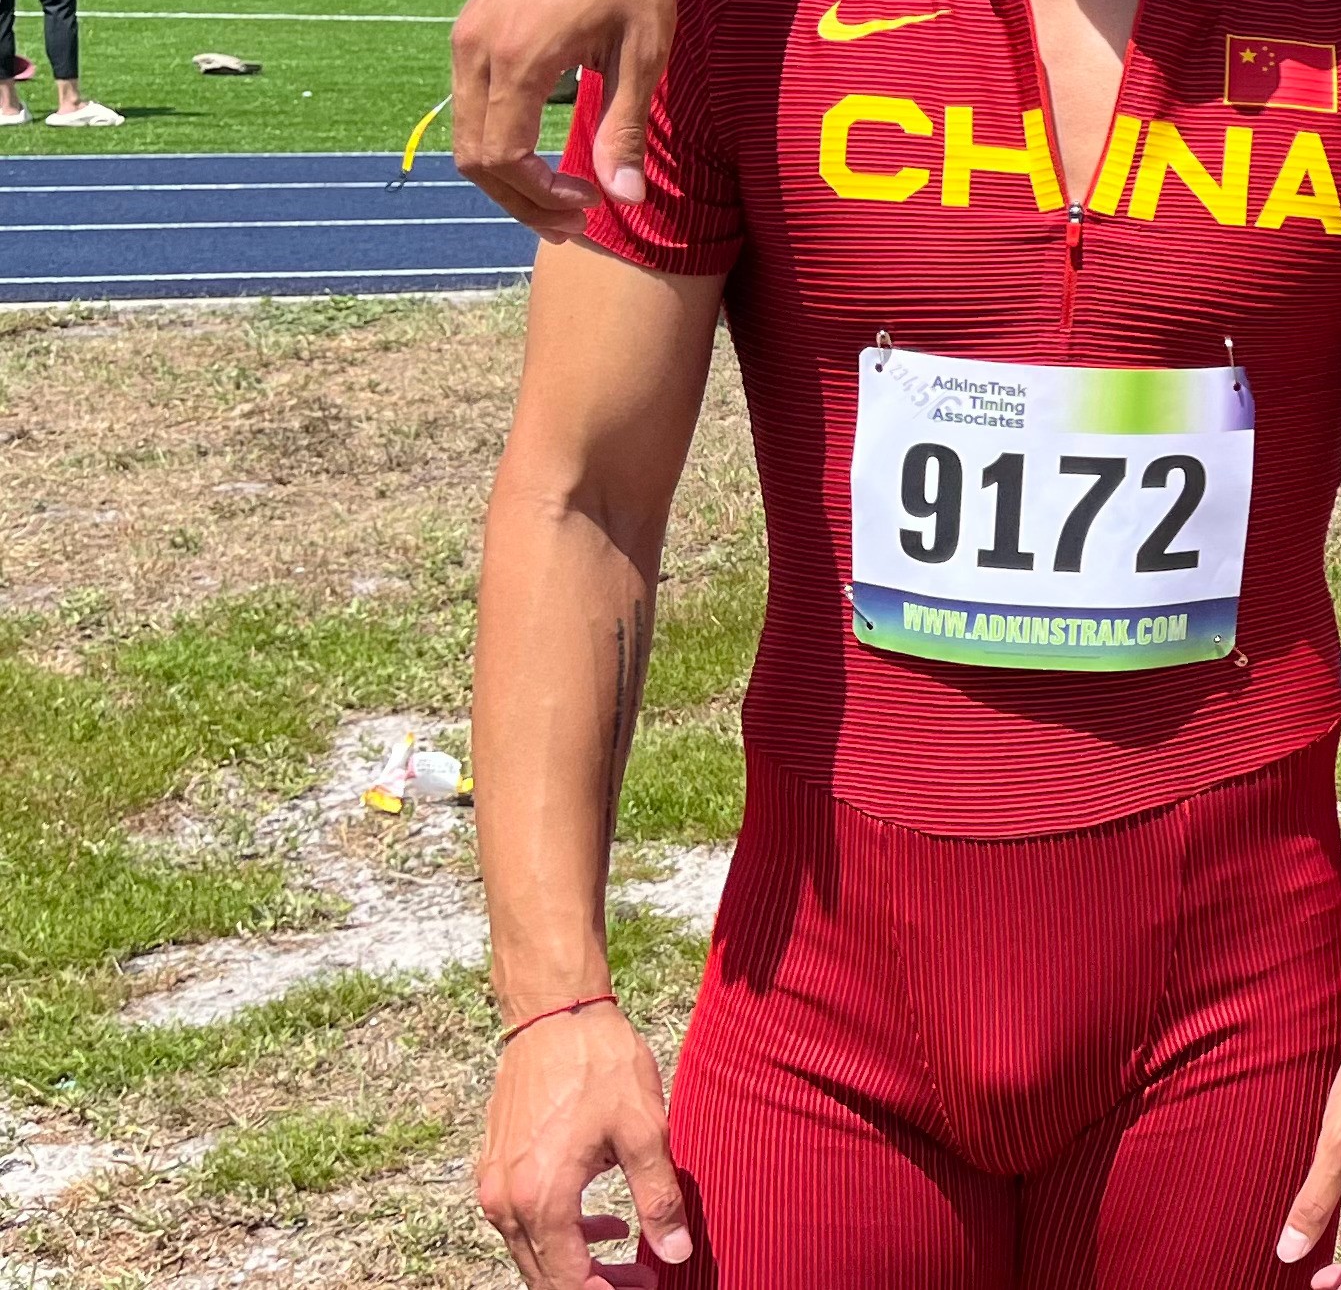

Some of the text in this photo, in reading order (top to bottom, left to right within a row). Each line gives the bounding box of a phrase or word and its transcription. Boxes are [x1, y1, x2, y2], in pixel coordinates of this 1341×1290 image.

[931, 376, 1027, 397] AdkinsTrak
[969, 396, 1026, 416] Timing
[932, 408, 1025, 429] Associates
[898, 442, 1207, 573] 9172
[902, 602, 1189, 647] WWW.ADKINSTRAK.COM
